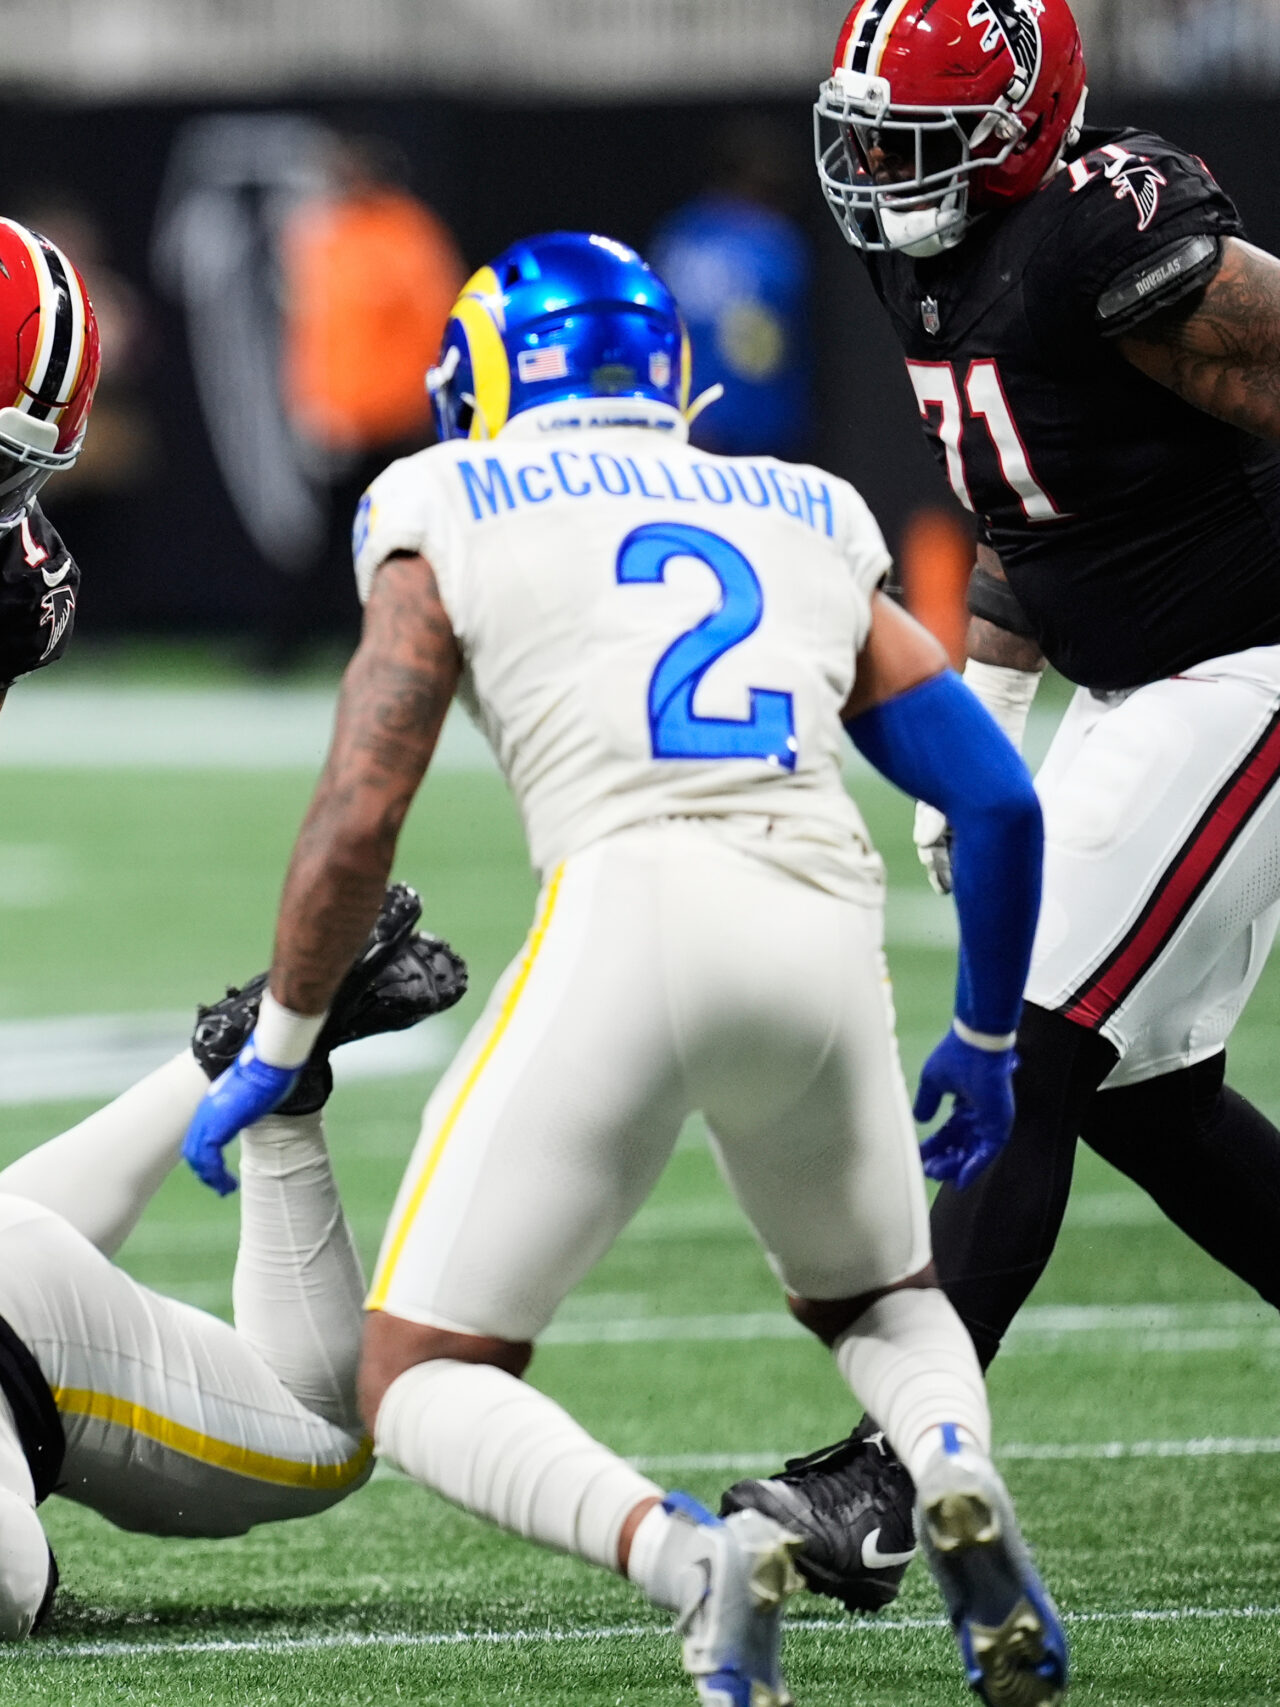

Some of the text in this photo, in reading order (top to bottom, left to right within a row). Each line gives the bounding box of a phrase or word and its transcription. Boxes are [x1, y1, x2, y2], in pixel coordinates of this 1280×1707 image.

[1135, 257, 1181, 296] DOUGLAS
[457, 450, 836, 538] McCOLLOUGH
[905, 357, 1078, 522] 71
[615, 521, 797, 773] 2
